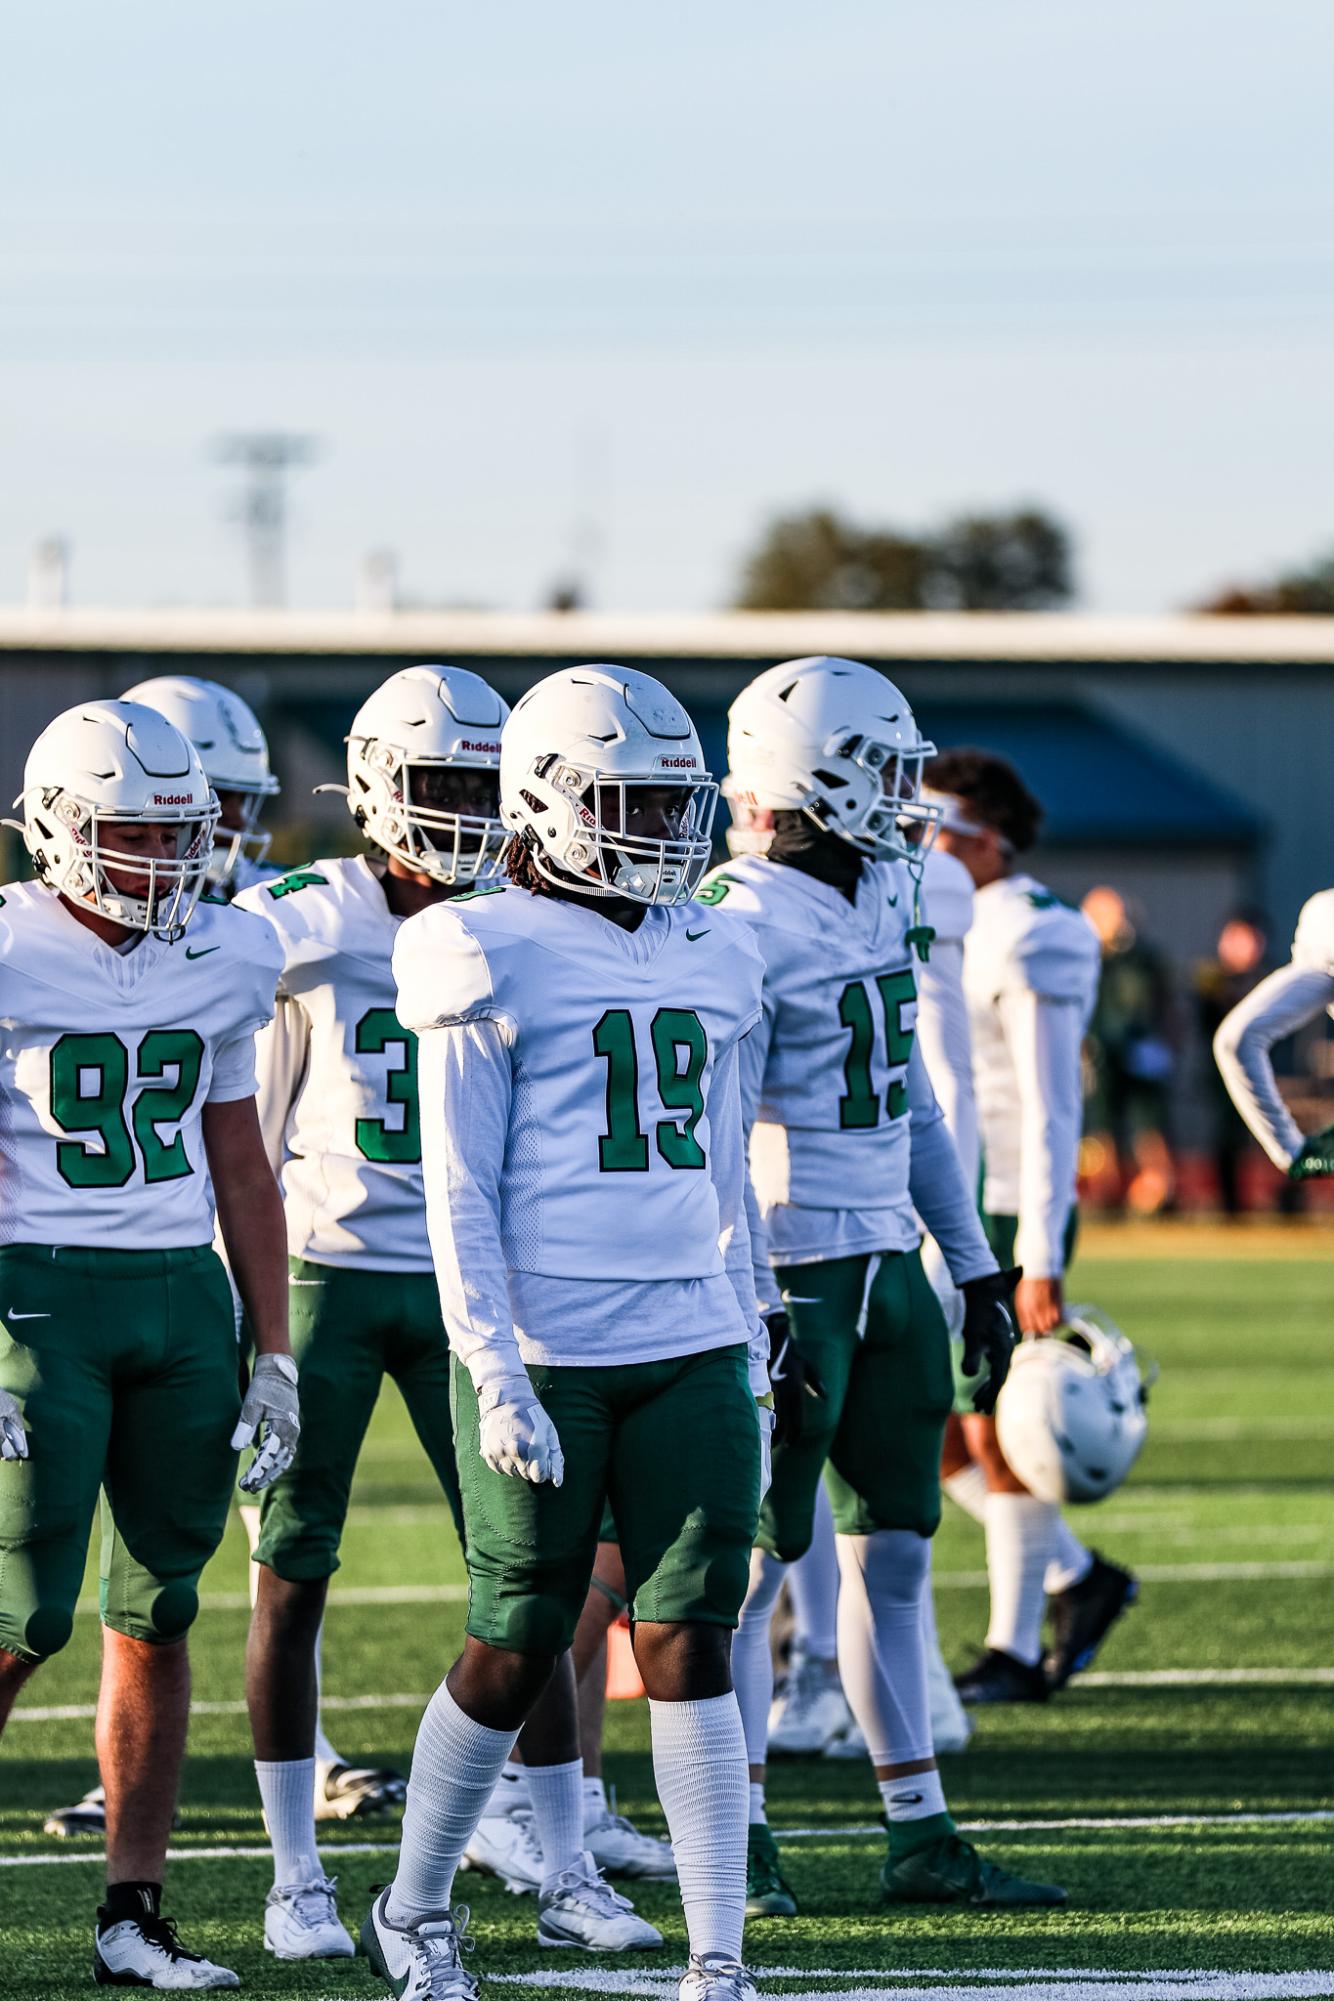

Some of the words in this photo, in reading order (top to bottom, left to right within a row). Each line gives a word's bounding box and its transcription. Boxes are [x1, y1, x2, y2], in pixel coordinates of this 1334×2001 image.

[153, 794, 193, 805] Riddell
[661, 757, 697, 769] Riddell
[49, 1029, 205, 1188] 92
[355, 1007, 421, 1164] 3
[592, 1007, 708, 1173] 19
[838, 968, 918, 1129] 15
